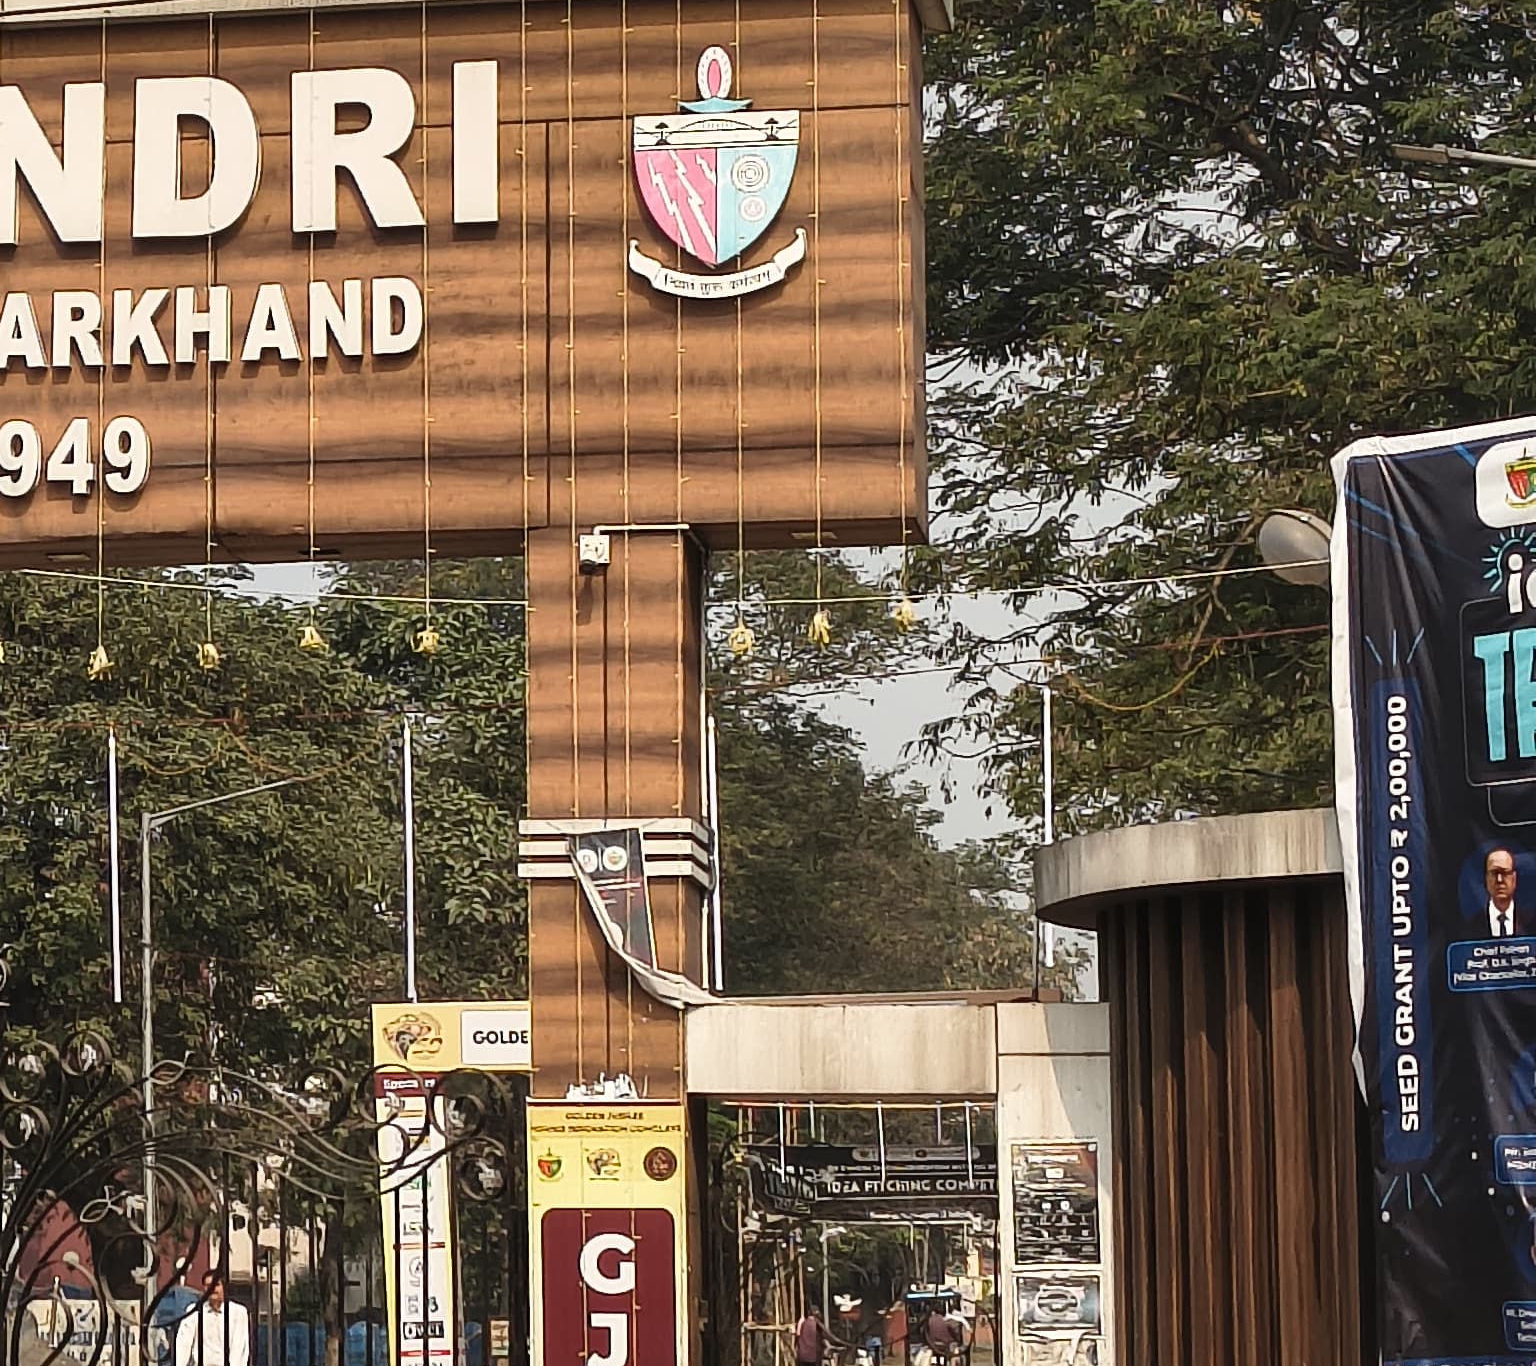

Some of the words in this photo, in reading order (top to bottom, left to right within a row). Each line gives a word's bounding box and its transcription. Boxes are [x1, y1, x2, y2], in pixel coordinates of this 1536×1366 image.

[1386, 695, 1413, 822] 2,00,000
[1390, 855, 1413, 937] UPTO
[1392, 943, 1416, 1046] GRANT
[472, 1030, 529, 1045] GOLDE
[1395, 1054, 1420, 1132] SEED
[827, 1181, 860, 1193] IDEA
